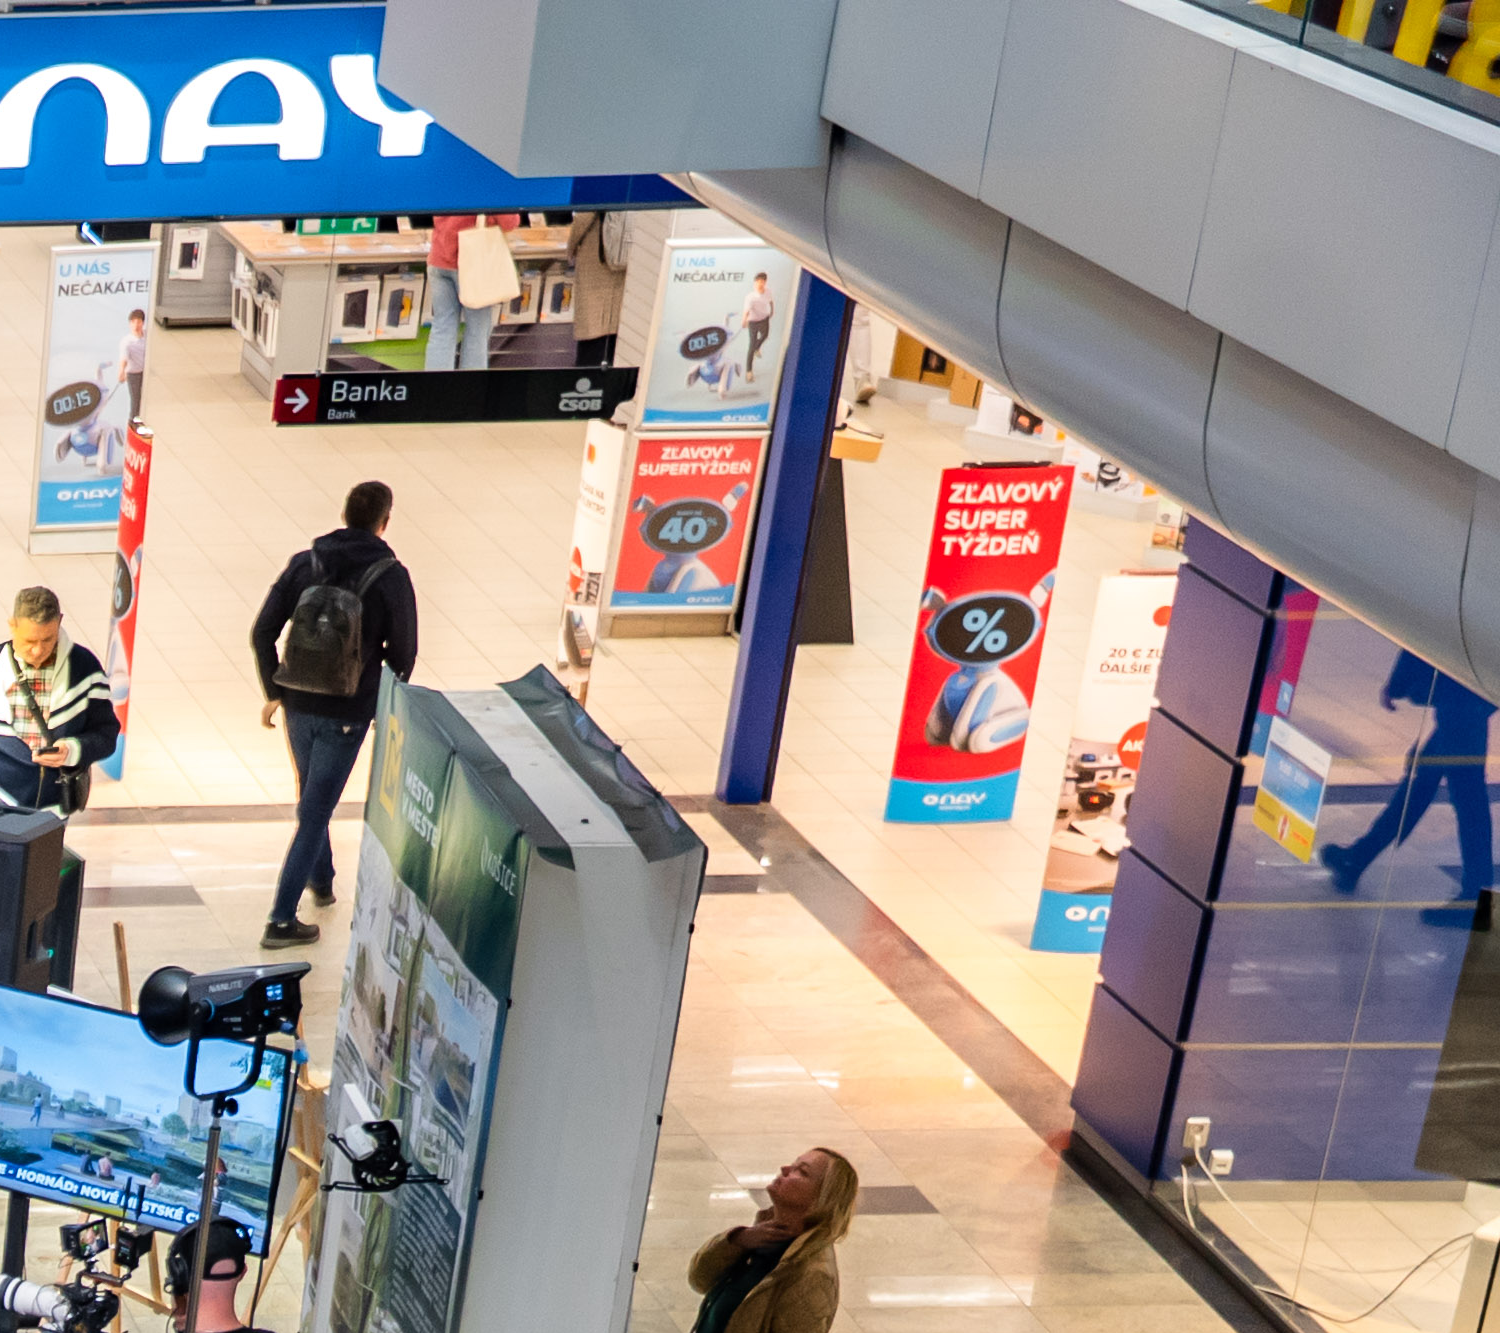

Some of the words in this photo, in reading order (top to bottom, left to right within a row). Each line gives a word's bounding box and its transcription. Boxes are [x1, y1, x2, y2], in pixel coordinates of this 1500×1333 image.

[60, 264, 72, 278] U
[77, 260, 111, 276] NÁS
[676, 257, 687, 268] U
[689, 256, 716, 268] NÁS
[673, 270, 745, 283] NEČAKÁTE!
[57, 279, 150, 297] NEČAKÁTE!
[331, 380, 408, 402] Banka
[53, 389, 92, 416] 00:15
[559, 397, 602, 412] ČSOB
[327, 408, 356, 420] Bank
[660, 443, 735, 461] ZĽAVOVÝ
[638, 458, 752, 477] SUPERTÝŽDEŇ
[948, 475, 1065, 504] ZĽAVOVÝ
[944, 508, 1027, 530] SUPER
[941, 530, 1040, 557] TÝŽDEŇ
[962, 608, 1008, 654] %
[1109, 648, 1128, 659] 20
[404, 766, 434, 814] MESTO
[408, 805, 439, 849] MESTE
[16, 1167, 78, 1195] HORNÁD:
[80, 1185, 121, 1206] NOVÉ
